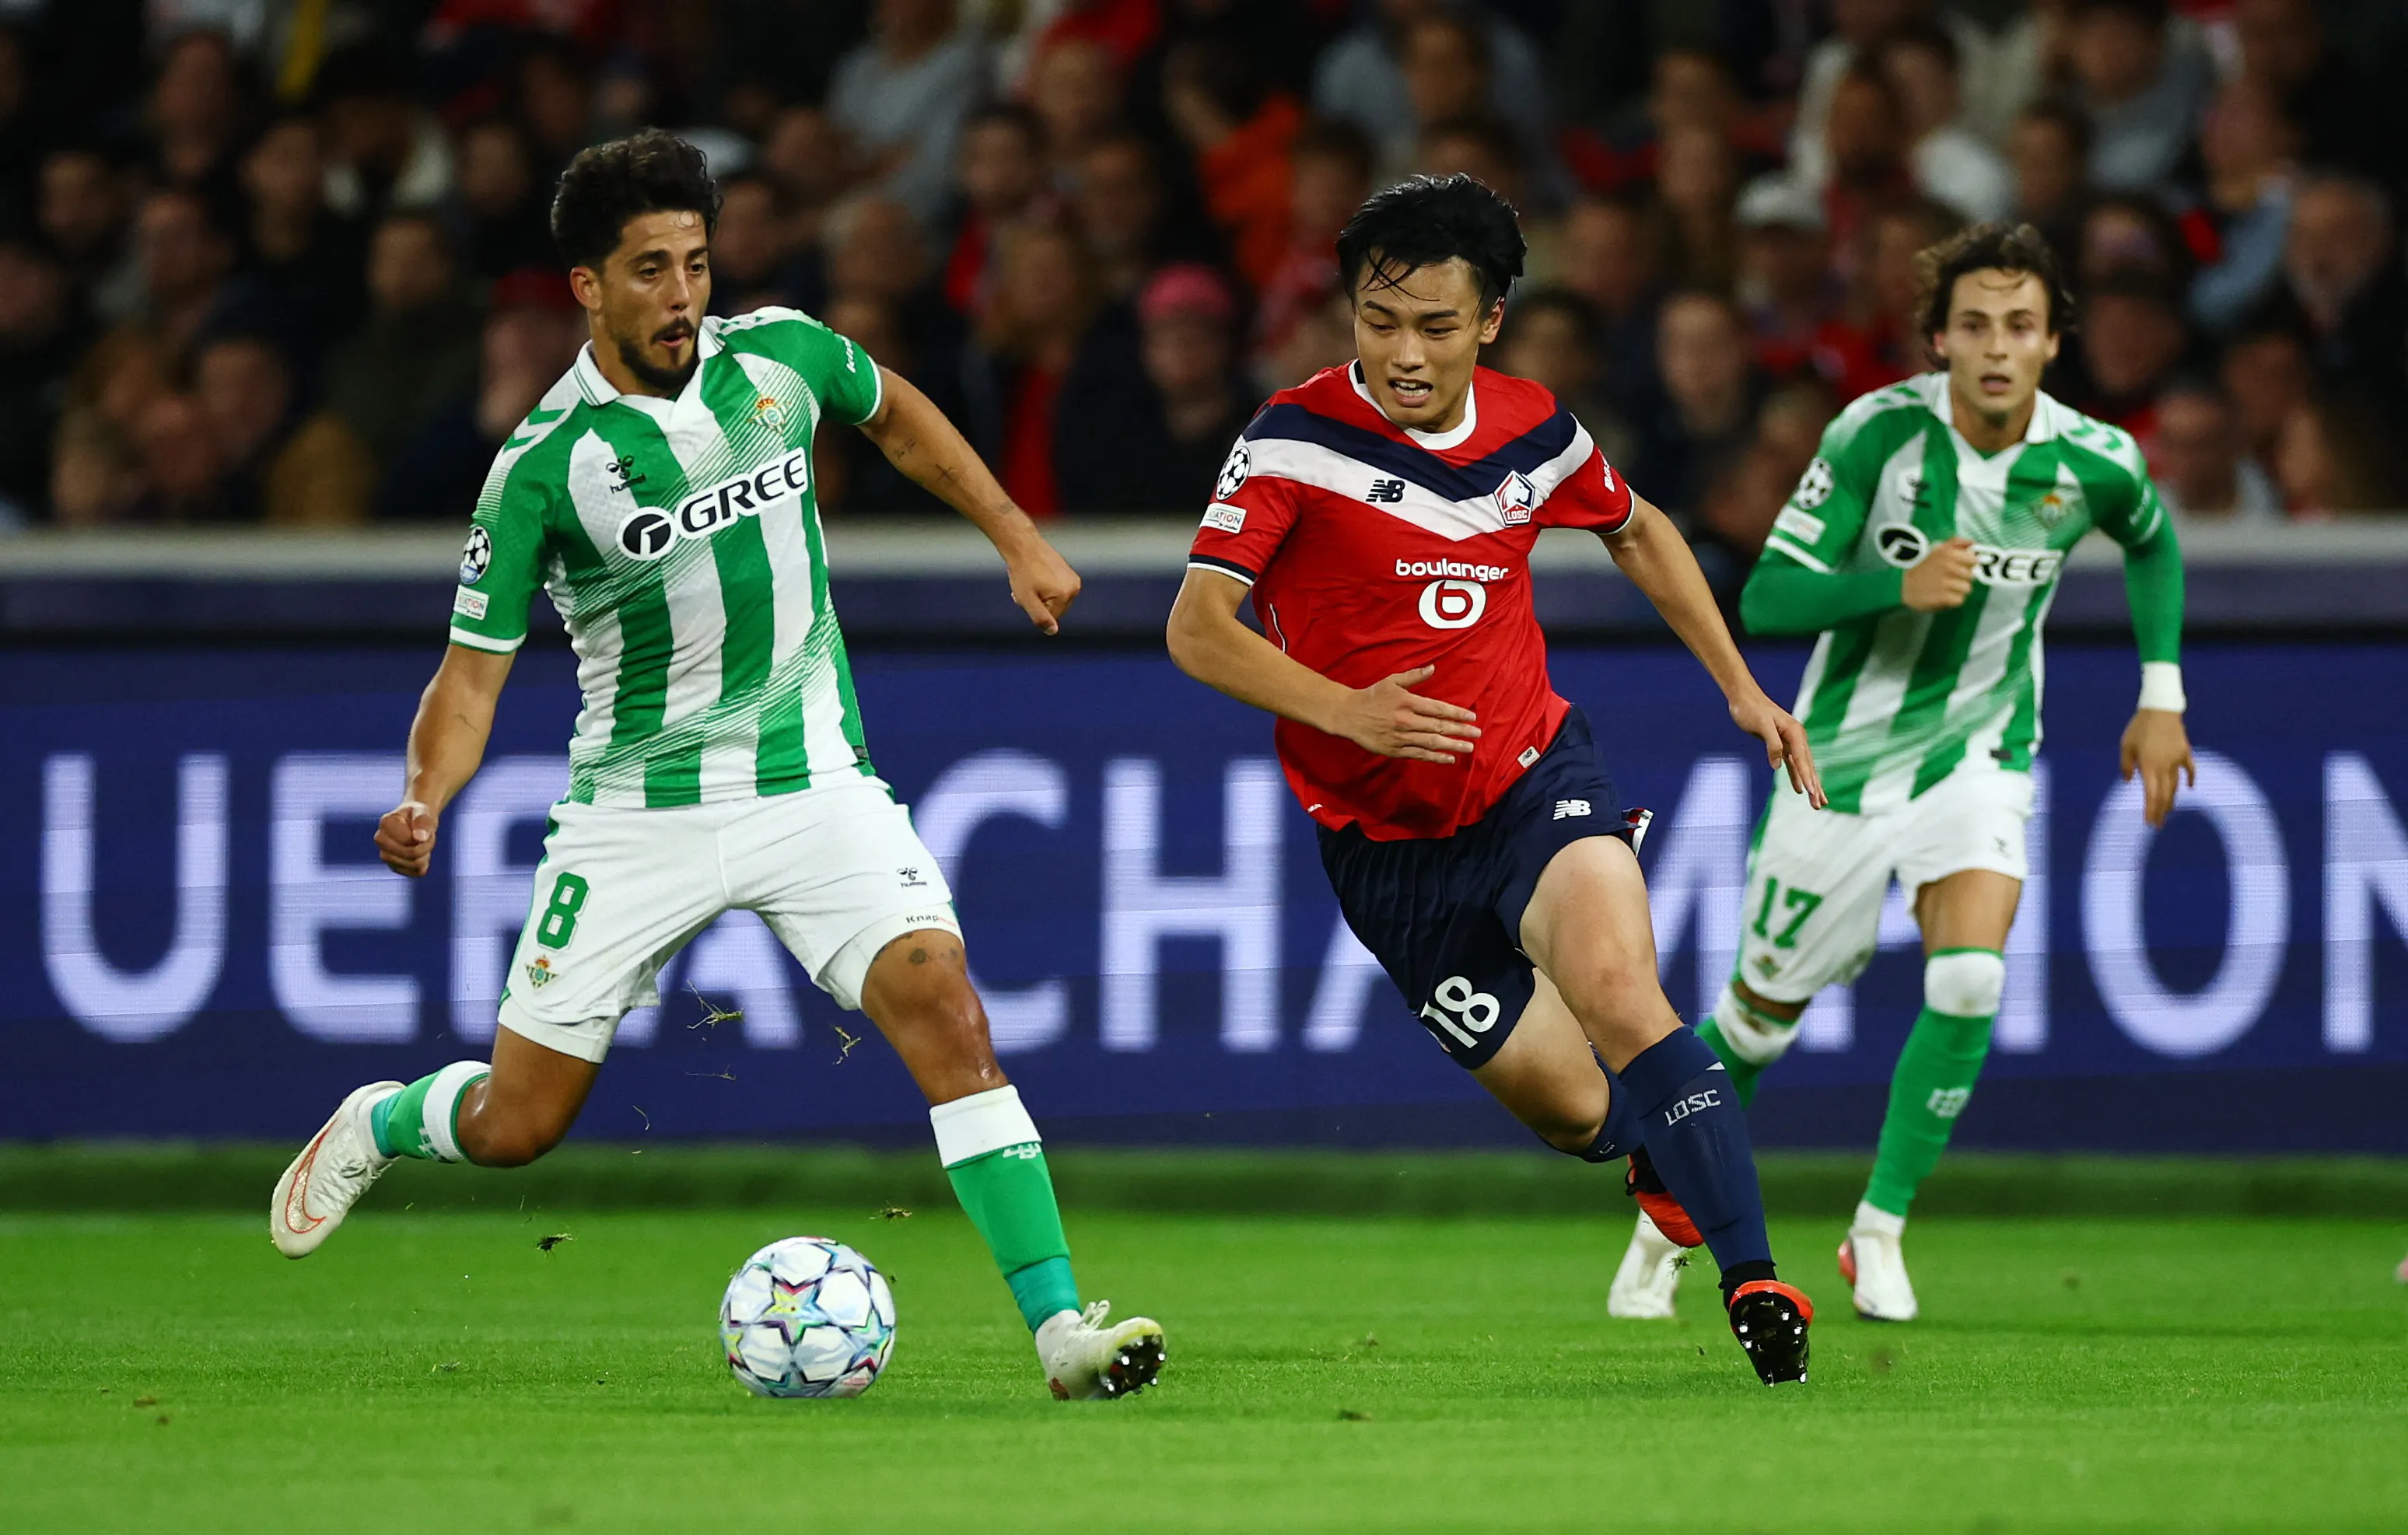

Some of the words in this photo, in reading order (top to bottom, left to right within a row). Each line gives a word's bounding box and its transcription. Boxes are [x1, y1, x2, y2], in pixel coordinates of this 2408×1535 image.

[681, 454, 805, 533] GREE
[1507, 510, 1528, 520] LOSC
[1395, 558, 1510, 582] boulanger
[1974, 551, 2059, 581] REE
[537, 872, 590, 952] 8
[1753, 876, 1824, 950] 17
[1420, 975, 1500, 1048] 18
[1664, 1089, 1721, 1126] LOSC
